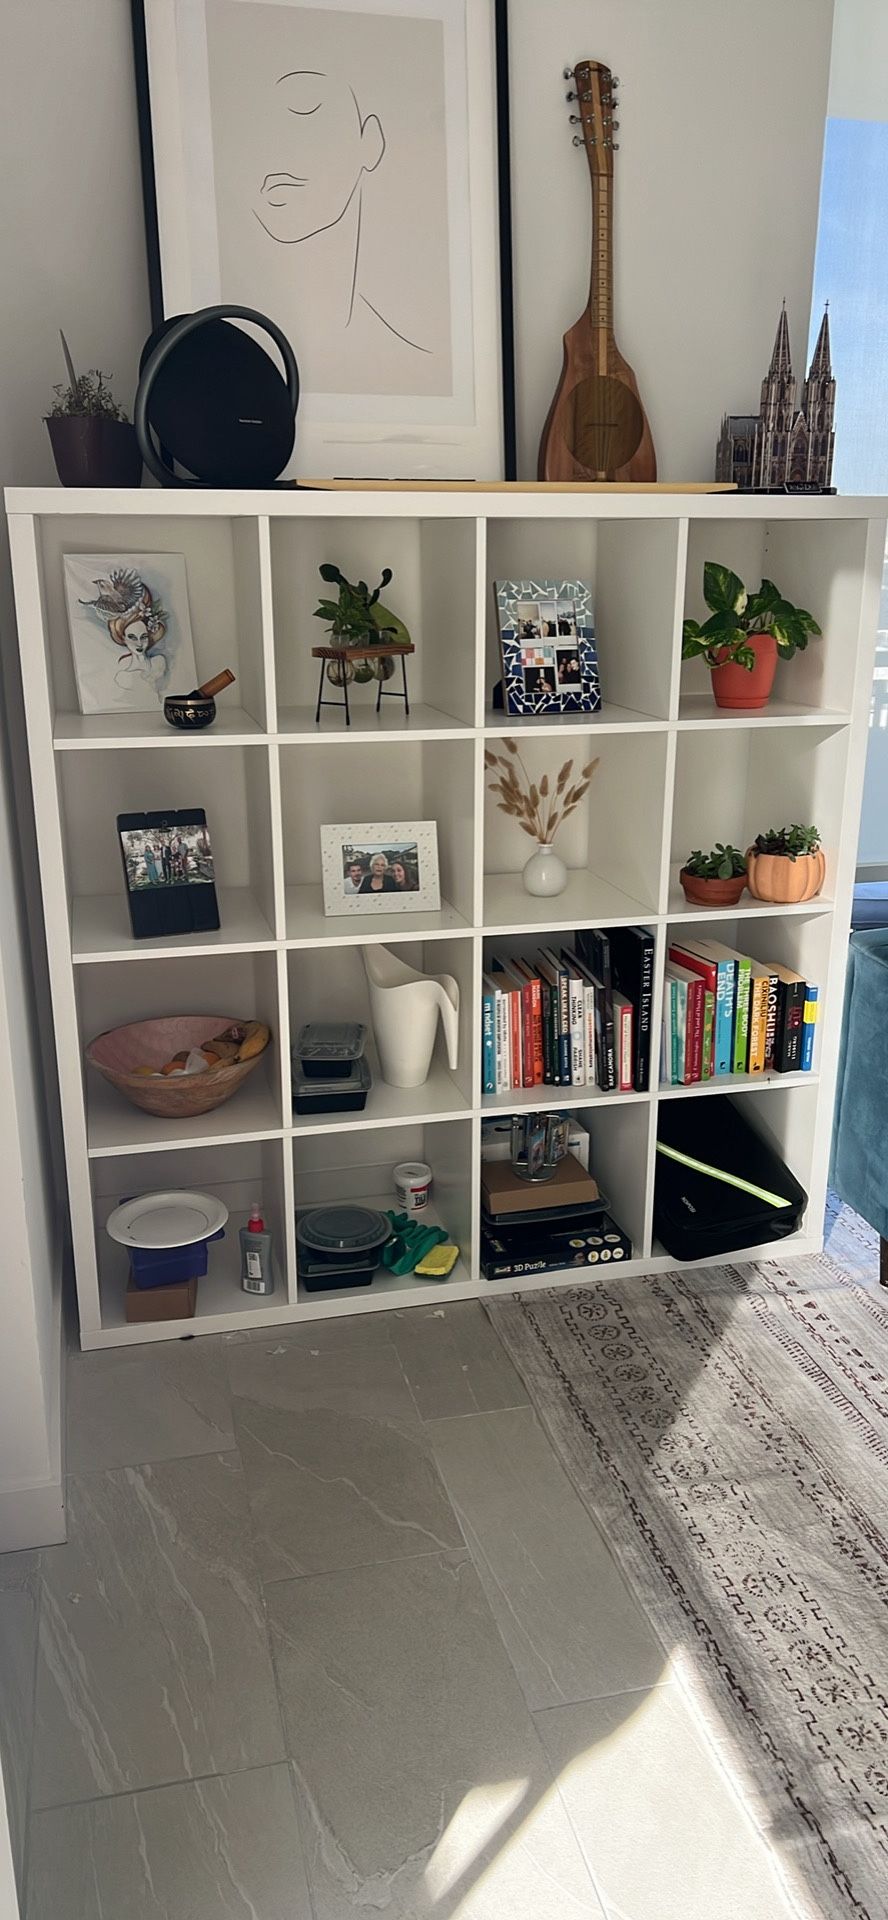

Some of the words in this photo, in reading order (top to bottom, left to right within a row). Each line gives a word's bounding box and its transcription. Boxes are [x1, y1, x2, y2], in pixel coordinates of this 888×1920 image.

[643, 948, 653, 987] EASTER
[717, 972, 726, 1001] END
[725, 963, 734, 1018] DEATH'S
[766, 977, 778, 1031] BAOSHU
[484, 1002, 494, 1036] mindset
[641, 994, 651, 1032] ISLAND
[514, 1264, 523, 1272] 3D
[525, 1261, 546, 1270] Puzzle
